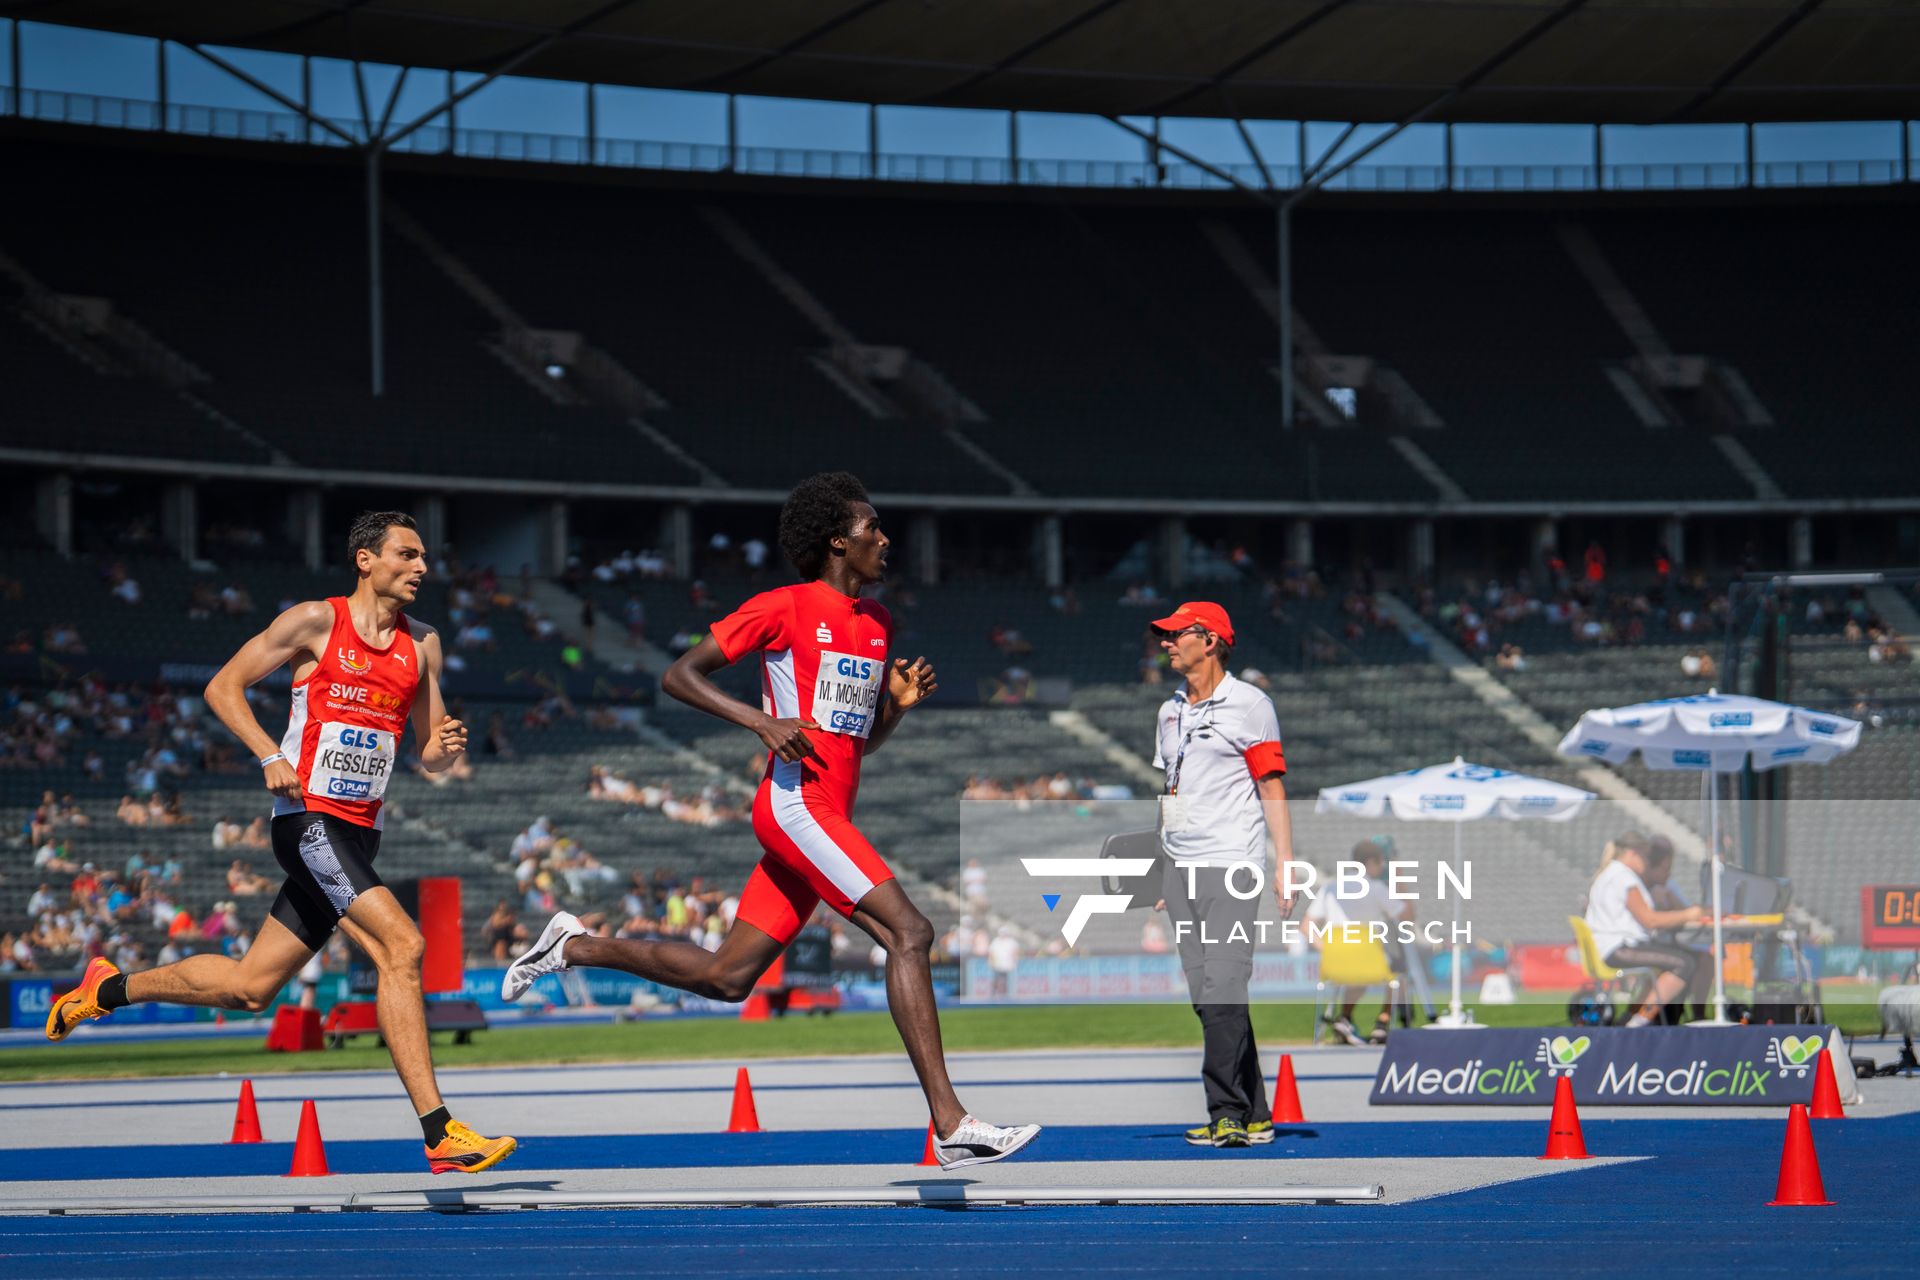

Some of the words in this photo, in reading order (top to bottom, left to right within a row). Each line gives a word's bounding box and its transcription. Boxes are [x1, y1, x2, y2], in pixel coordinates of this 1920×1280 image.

[329, 683, 368, 703] SWE
[819, 680, 832, 702] M.
[321, 749, 387, 777] KESSLER
[346, 782, 369, 793] PLAN
[1380, 1060, 1541, 1095] Mediclix
[1597, 1060, 1771, 1097] Mediclix
